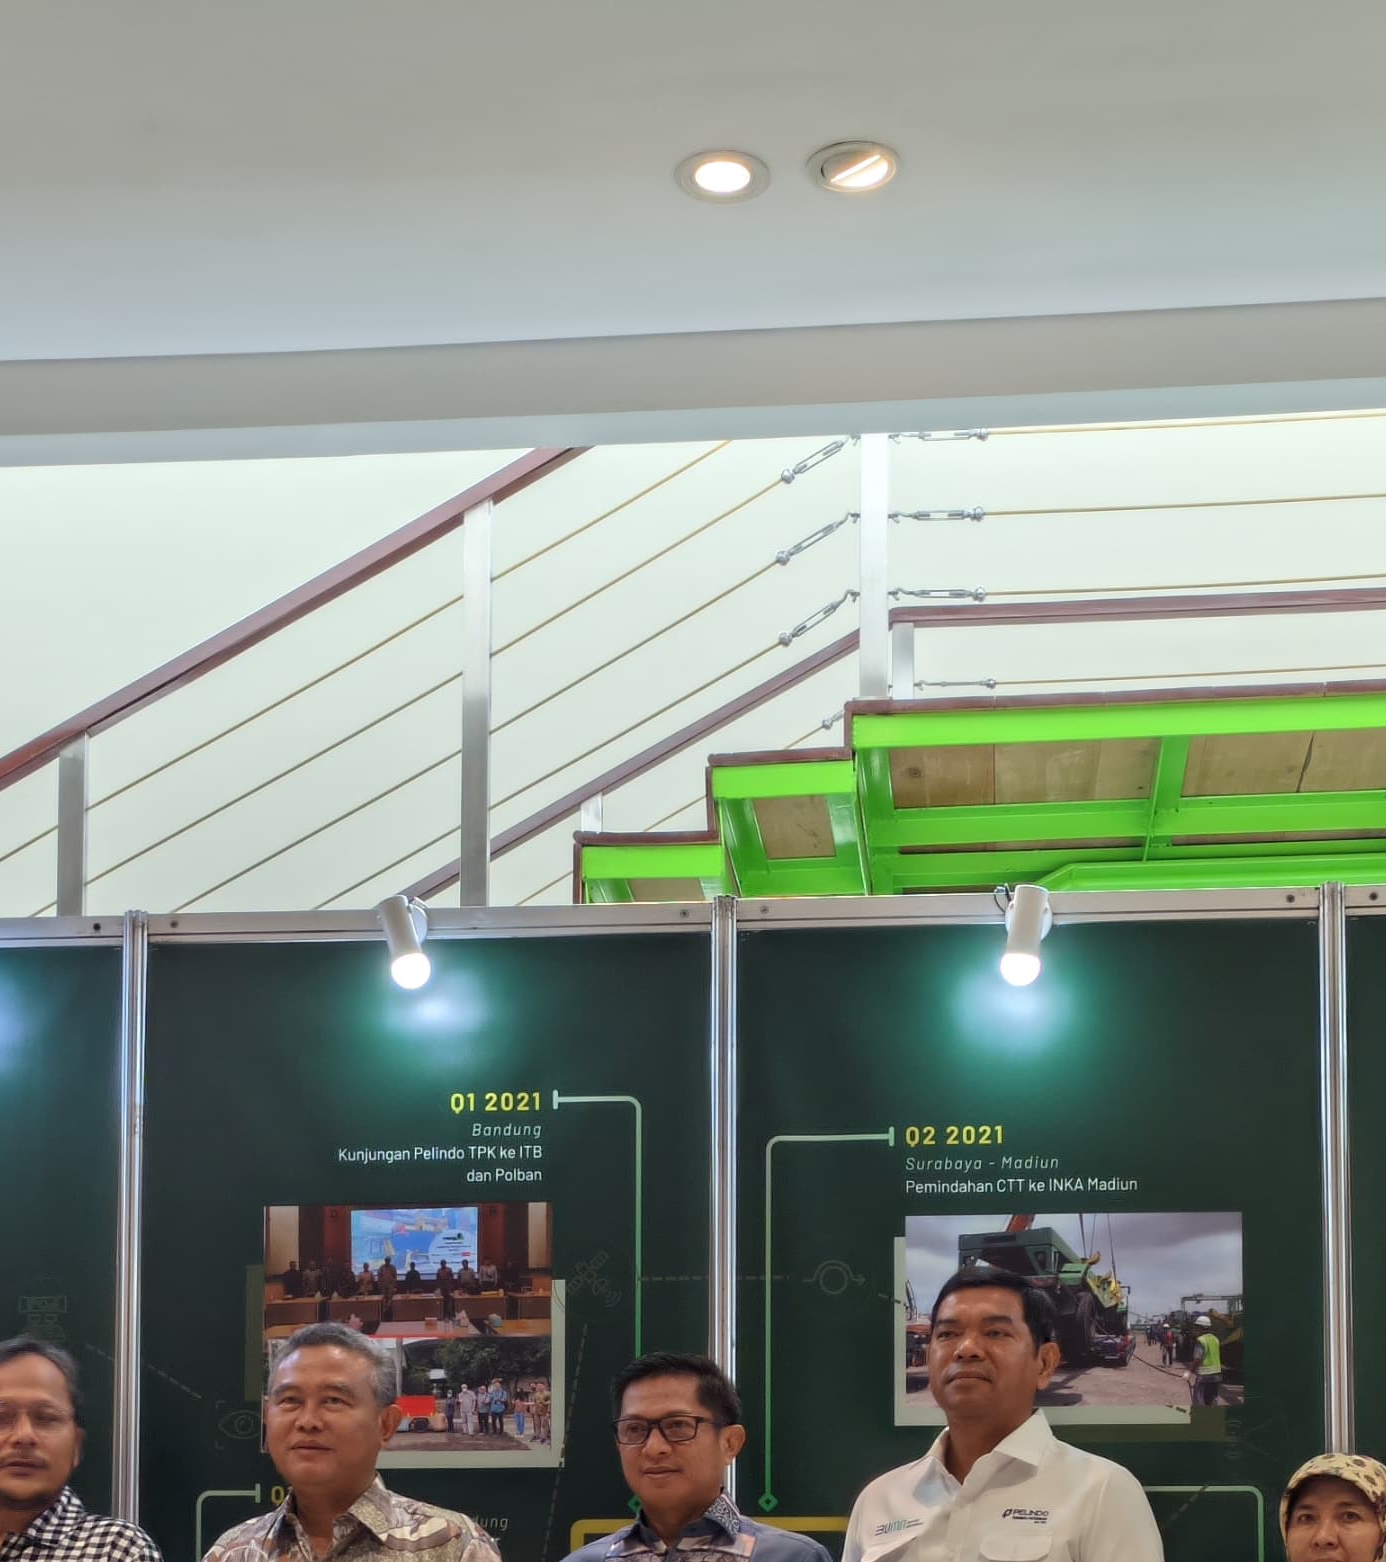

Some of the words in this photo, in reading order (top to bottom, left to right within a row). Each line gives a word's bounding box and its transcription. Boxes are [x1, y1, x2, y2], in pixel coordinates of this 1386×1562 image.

[450, 1092, 475, 1114] Q1
[484, 1092, 541, 1112] 2021
[472, 1123, 542, 1139] Bandung
[905, 1126, 936, 1147] Q2
[946, 1125, 1004, 1145] 2021
[338, 1148, 410, 1164] Kunjungan
[414, 1146, 464, 1160] Pelindo
[468, 1146, 496, 1159] TPK
[499, 1146, 516, 1159] ke
[519, 1145, 543, 1159] ITB
[905, 1157, 982, 1173] Surabaya
[1001, 1156, 1060, 1169] Madiun
[467, 1169, 491, 1182] dan
[495, 1168, 542, 1182] Polban
[905, 1180, 993, 1194] Pemindahan
[996, 1179, 1025, 1193] CTT
[1028, 1179, 1045, 1192] ke
[1049, 1178, 1084, 1192] INKA
[1087, 1177, 1138, 1192] Madiun
